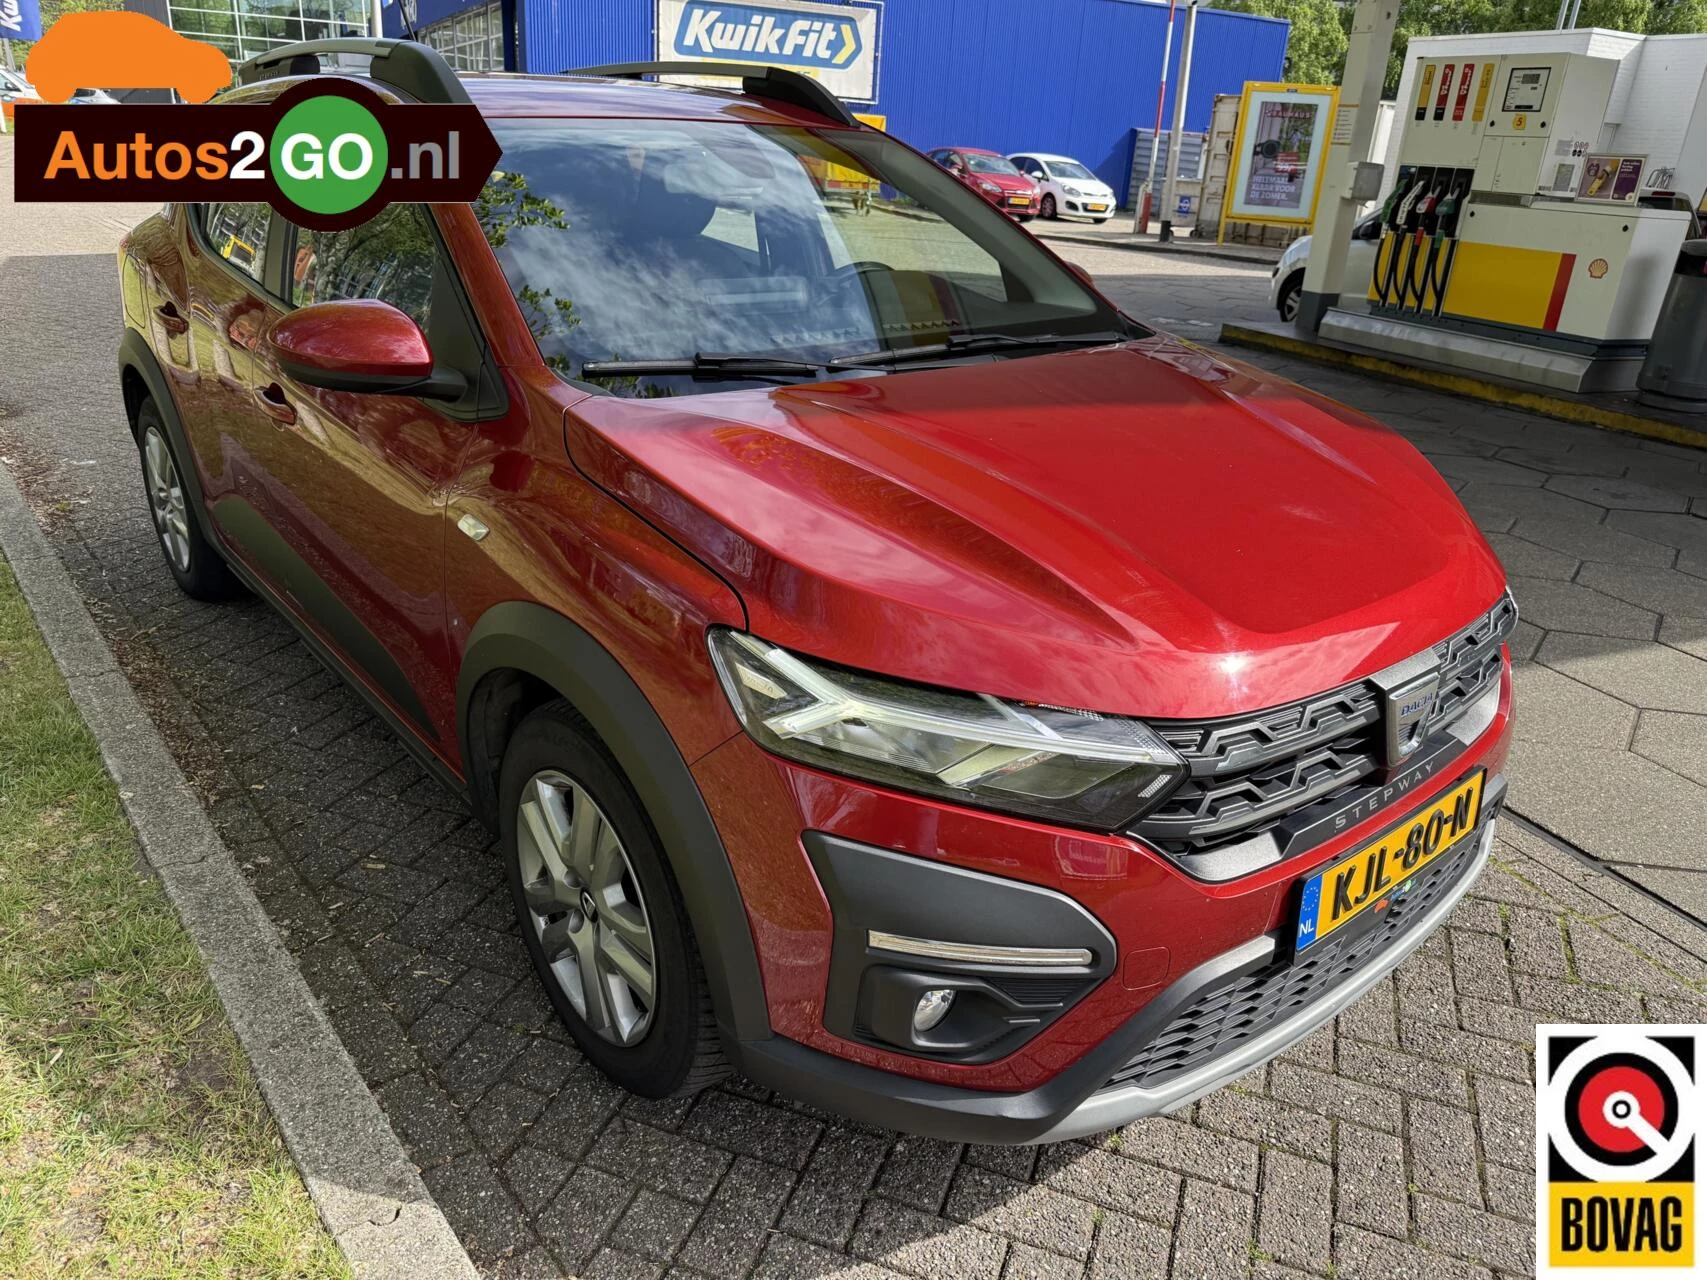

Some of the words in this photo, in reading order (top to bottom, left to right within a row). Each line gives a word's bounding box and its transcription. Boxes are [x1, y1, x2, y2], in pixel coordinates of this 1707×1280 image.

[1515, 117, 1523, 126] 5
[1401, 692, 1433, 716] DACIA
[1335, 762, 1433, 829] STEPWAY
[1331, 786, 1474, 921] KJL-80-N
[1299, 917, 1314, 938] NL
